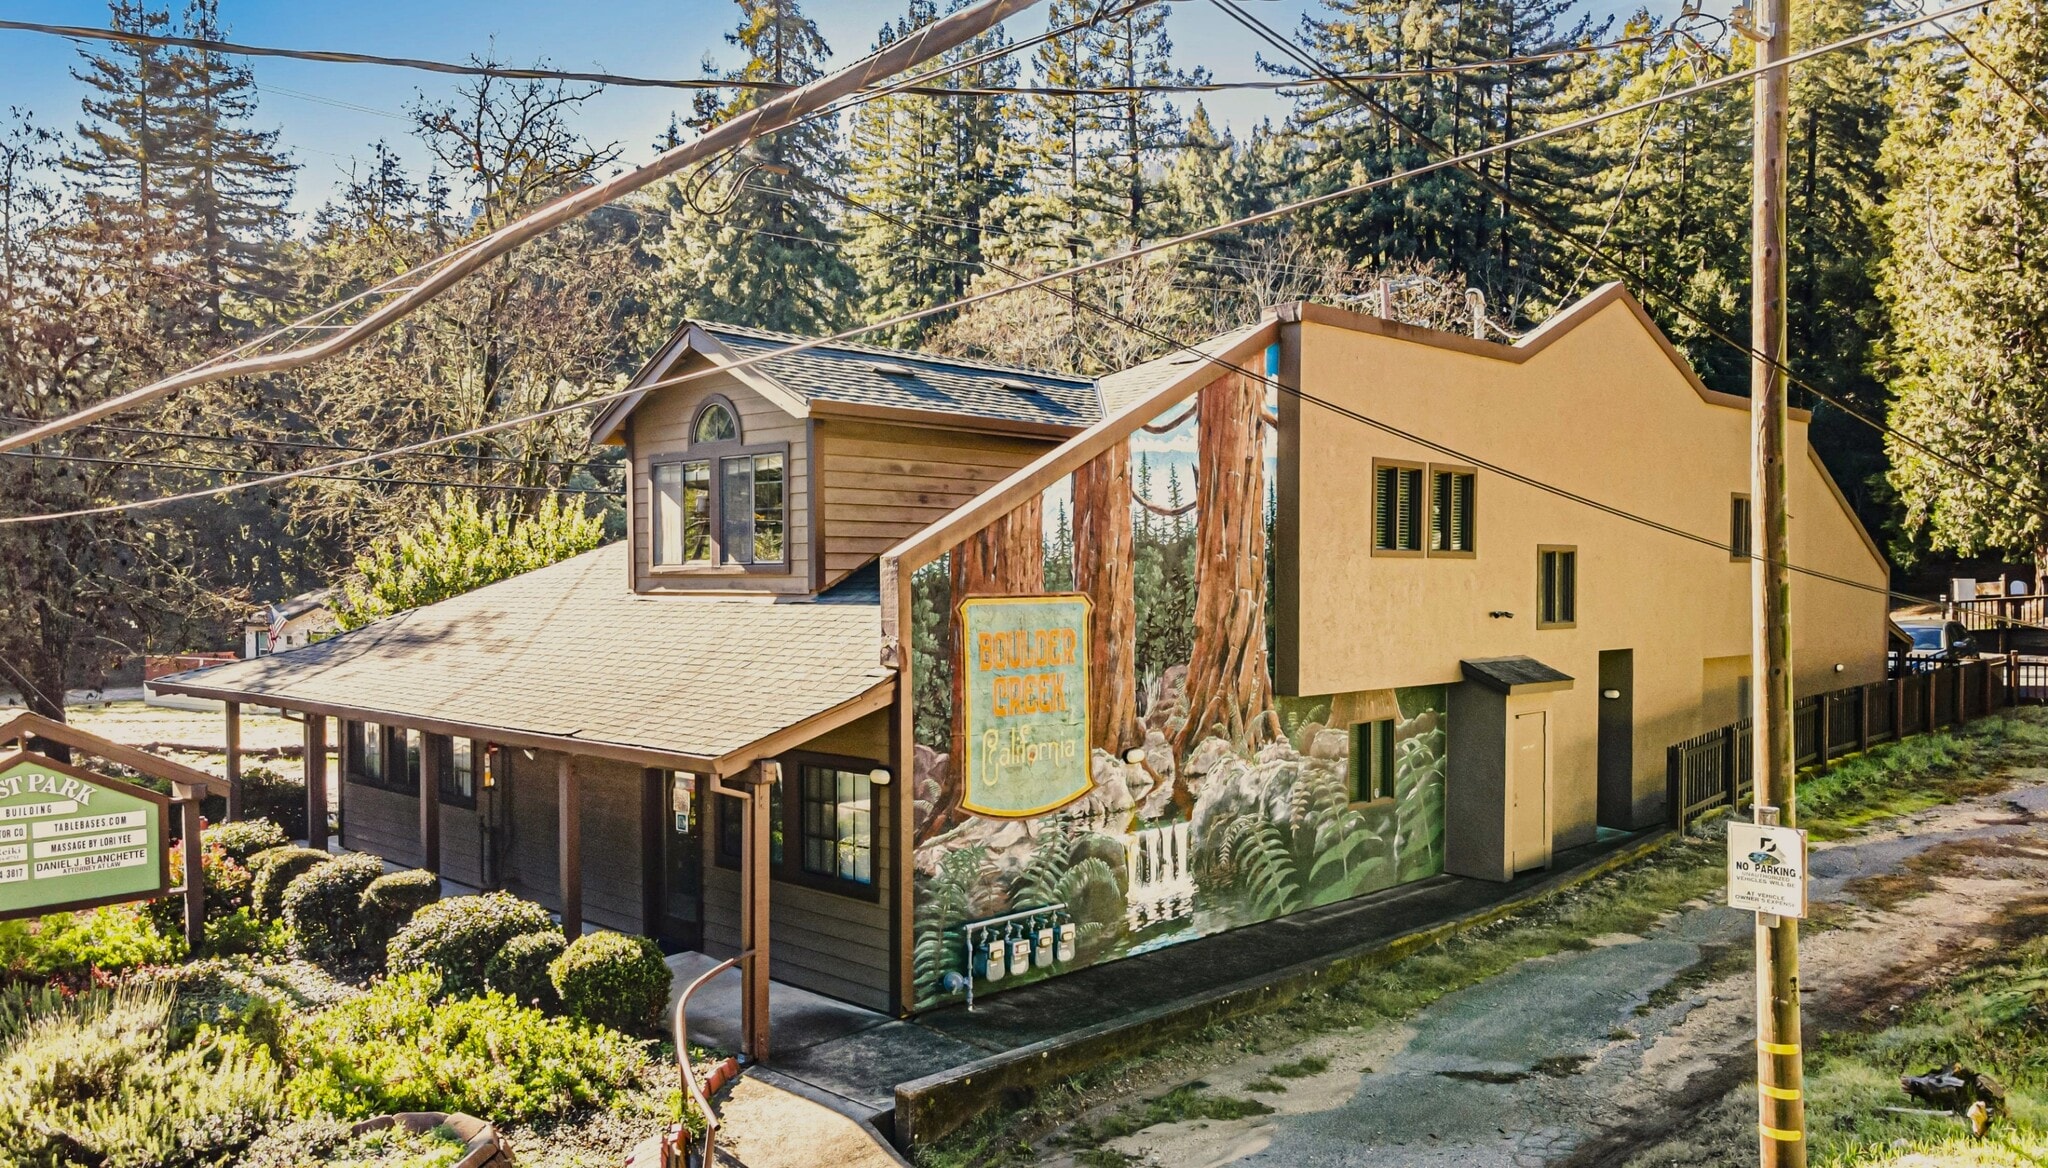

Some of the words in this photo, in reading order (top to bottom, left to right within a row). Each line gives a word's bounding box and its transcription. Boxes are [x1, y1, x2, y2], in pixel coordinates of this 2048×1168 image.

[978, 627, 1077, 671] BOULDER
[992, 672, 1067, 717] CREEK
[982, 724, 1076, 786] California
[28, 773, 97, 806] PARK
[6, 805, 52, 817] BUILDING
[55, 816, 127, 832] TABLEBASES.COM
[14, 828, 23, 837] CO
[51, 841, 86, 852] MASSAGE
[89, 839, 97, 848] BY
[100, 837, 116, 847] LORI
[118, 834, 131, 844] YEE
[0, 847, 21, 855] eiki
[36, 860, 71, 872] DANIEL
[74, 859, 82, 867] J.
[85, 850, 145, 865] BLANCHETTE
[63, 863, 96, 874] ATTORNEY
[7, 868, 23, 878] 3817
[1736, 862, 1749, 870] NO
[1755, 864, 1796, 877] PARKING
[1741, 872, 1790, 882] UNAUTHORIZED
[1736, 876, 1767, 884] VEHICLES
